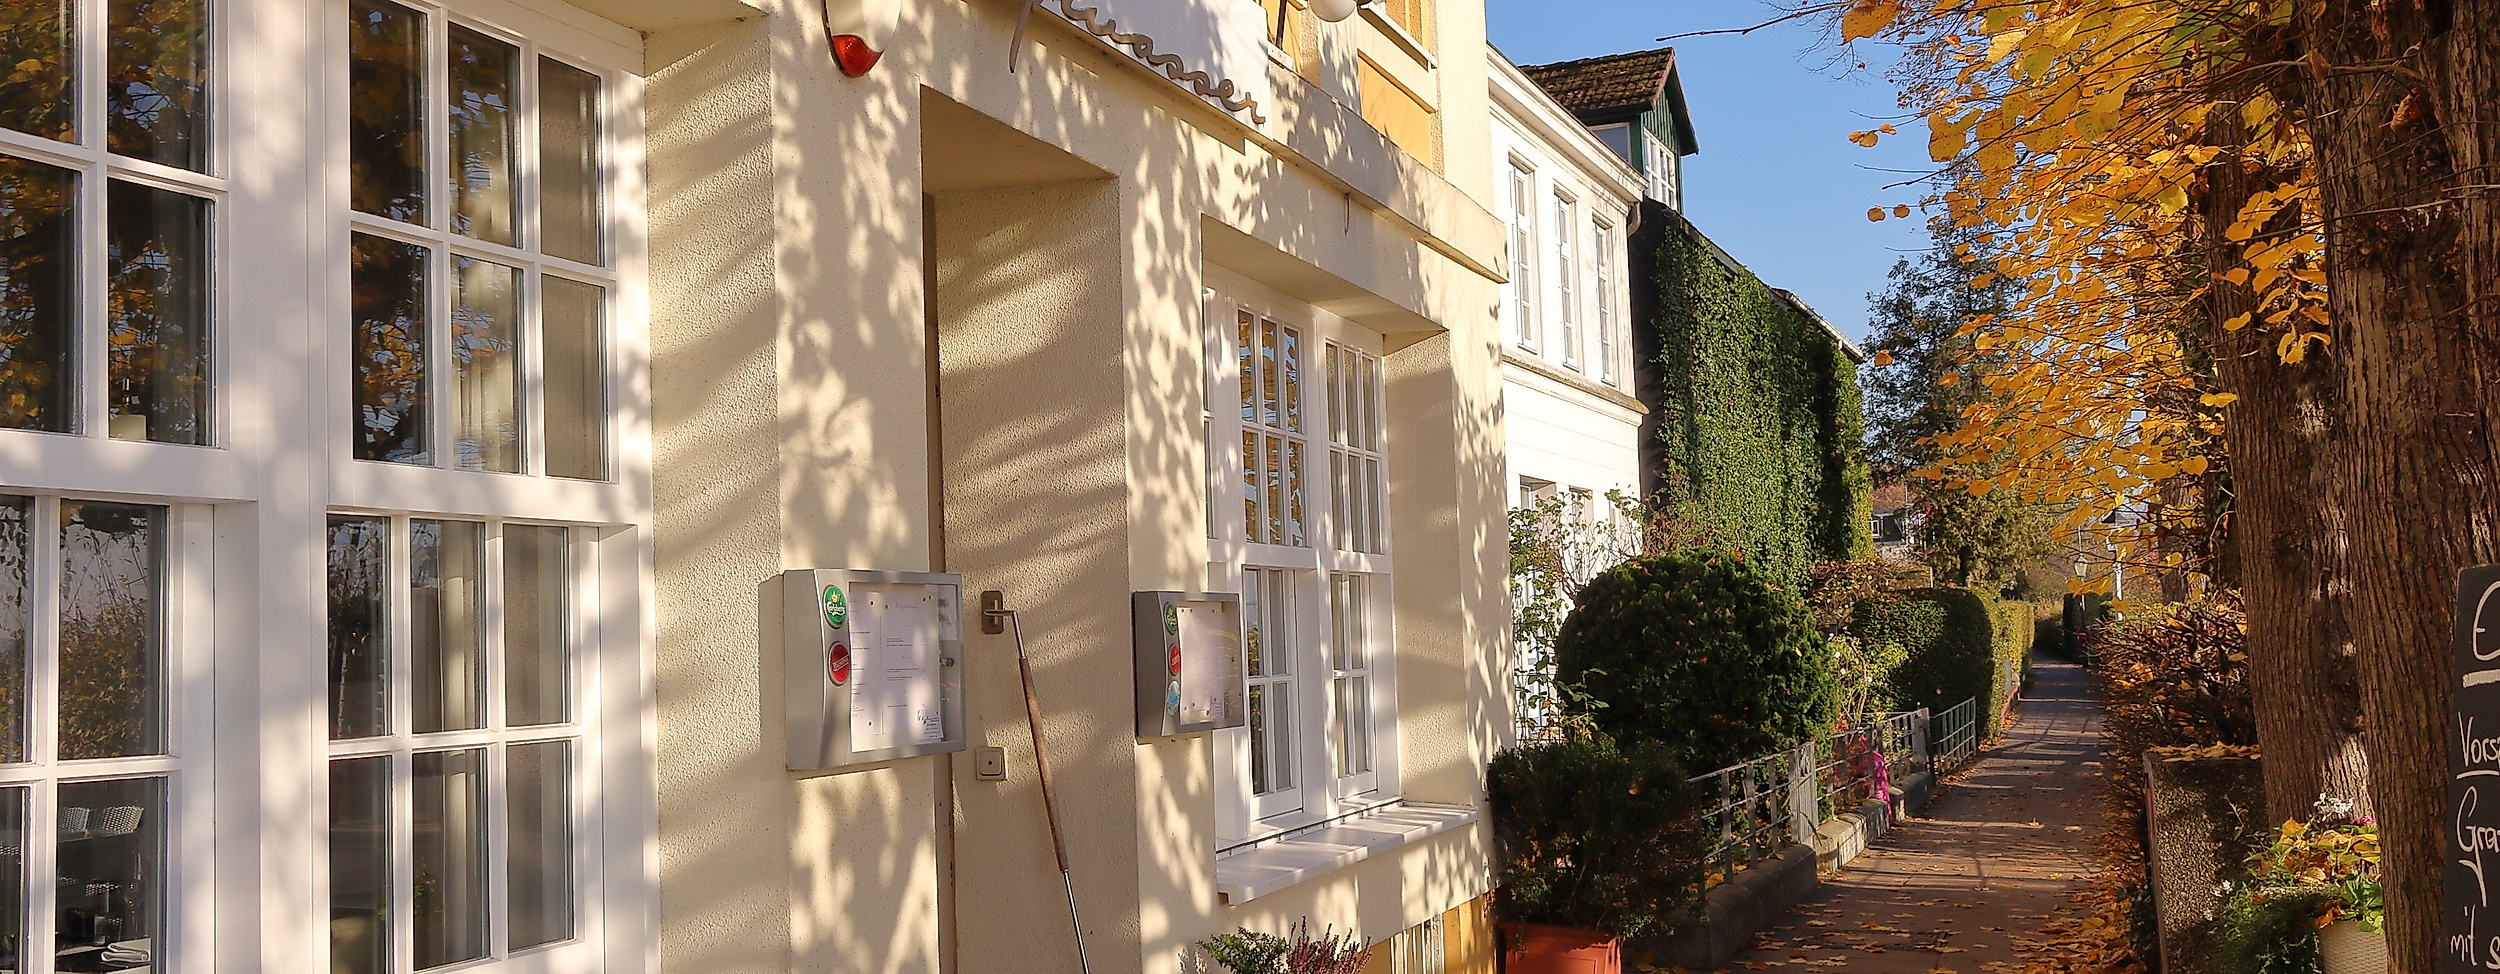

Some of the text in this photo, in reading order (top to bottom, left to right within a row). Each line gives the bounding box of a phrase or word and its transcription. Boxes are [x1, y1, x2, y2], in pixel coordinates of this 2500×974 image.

[1009, 0, 1266, 124] wasser
[2456, 785, 2500, 907] Gra
[2450, 904, 2478, 966] mit
